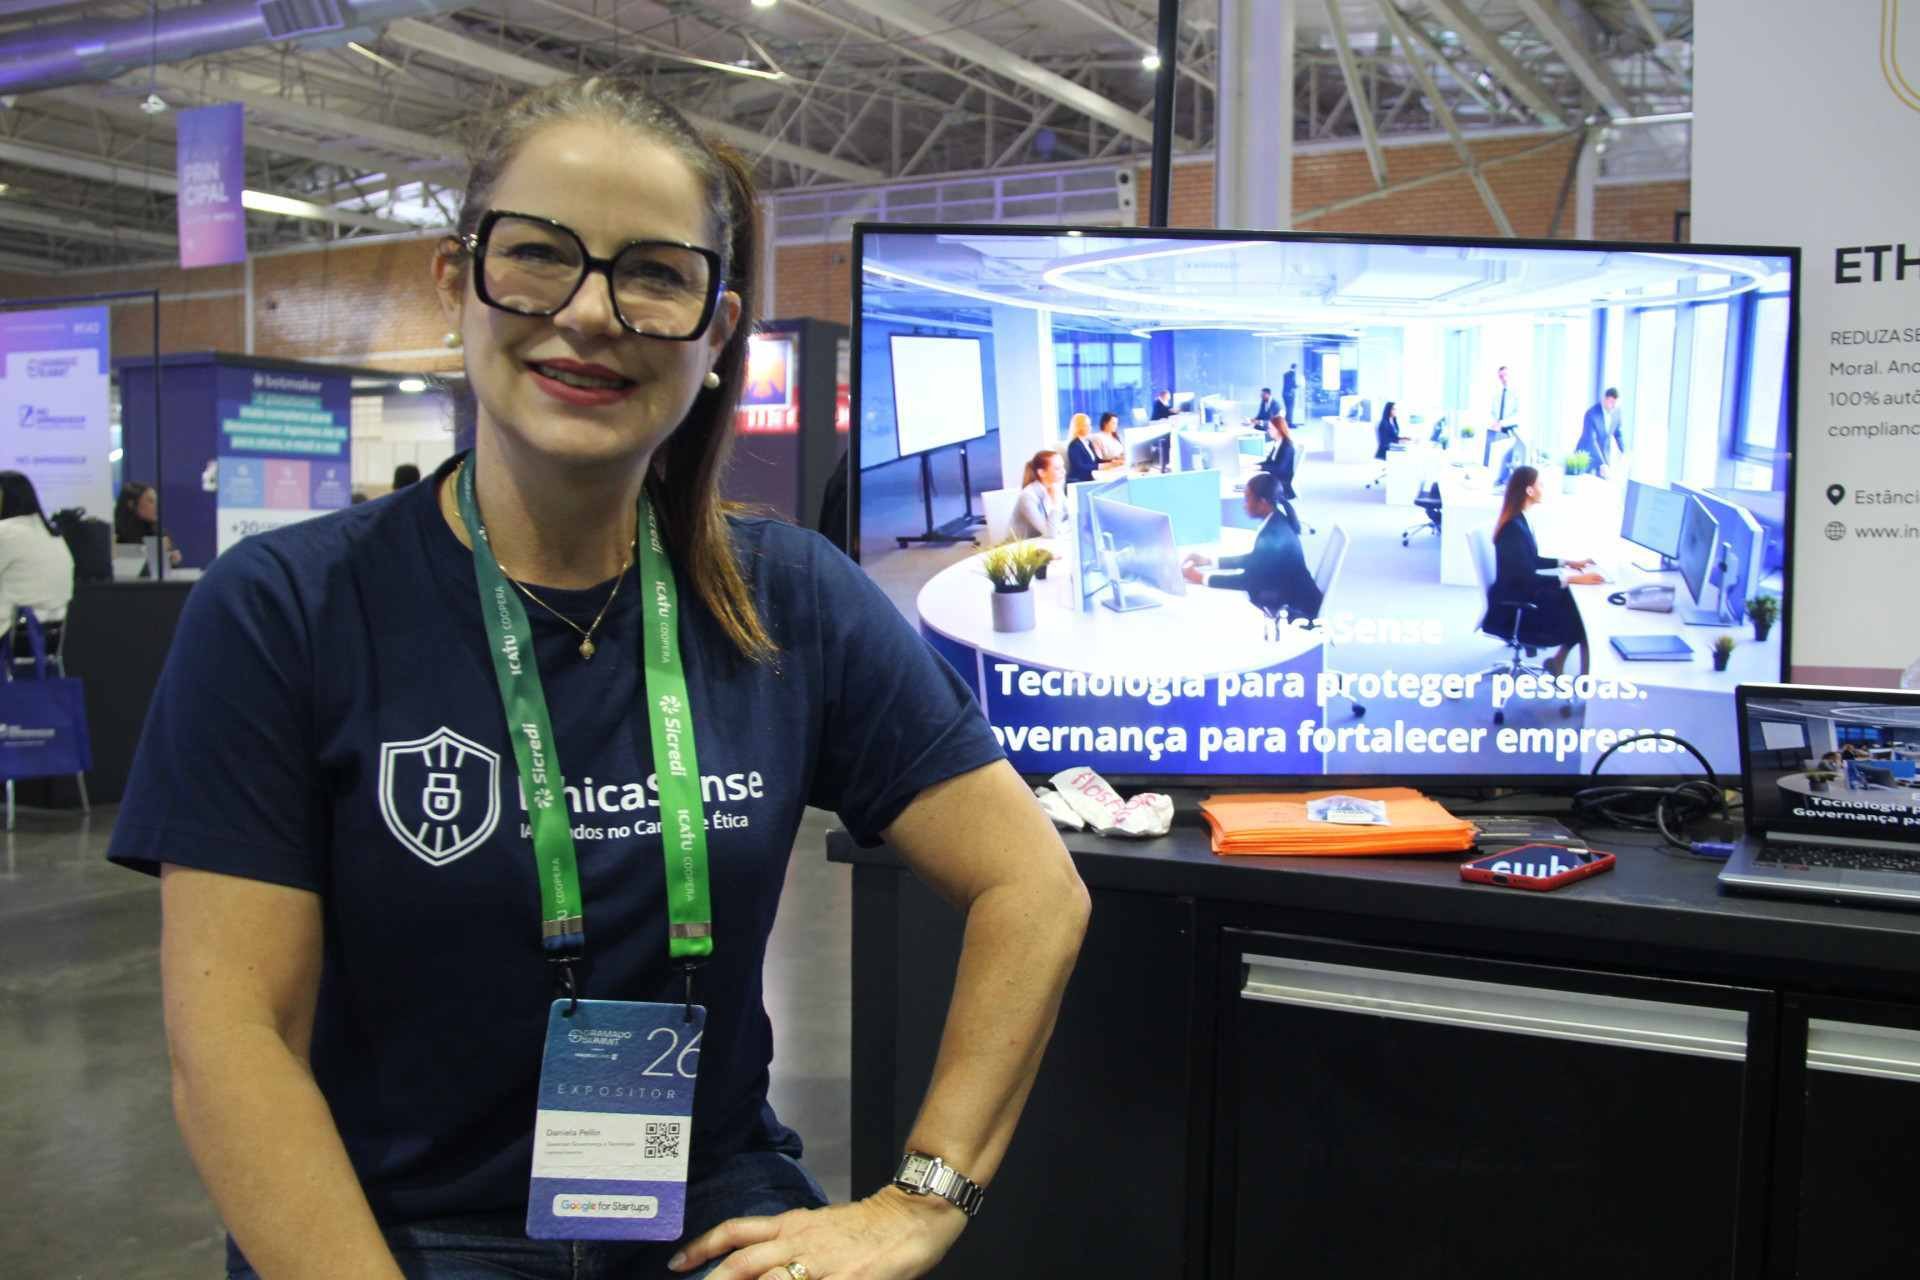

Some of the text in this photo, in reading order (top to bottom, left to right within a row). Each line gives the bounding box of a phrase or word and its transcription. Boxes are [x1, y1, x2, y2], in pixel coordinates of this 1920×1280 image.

[1830, 329, 1901, 345] REDUZA
[1829, 360, 1883, 376] Moral.
[1827, 391, 1880, 407] 100%
[995, 663, 1648, 708] Tecnologia para proteger pessoas.
[663, 716, 688, 778] Sicredi
[1199, 725, 1287, 762] para
[1297, 719, 1487, 754] fortalecer
[1496, 727, 1687, 763] empresas.
[521, 722, 548, 785] Sicredi
[1810, 796, 1907, 813] Tecnologia
[1792, 807, 1899, 824] Governança
[608, 826, 631, 839] no
[713, 810, 749, 829] Ética
[641, 1027, 703, 1078] 26
[557, 1085, 677, 1100] EXPOSITOR
[561, 1199, 650, 1213] Google for Startups
